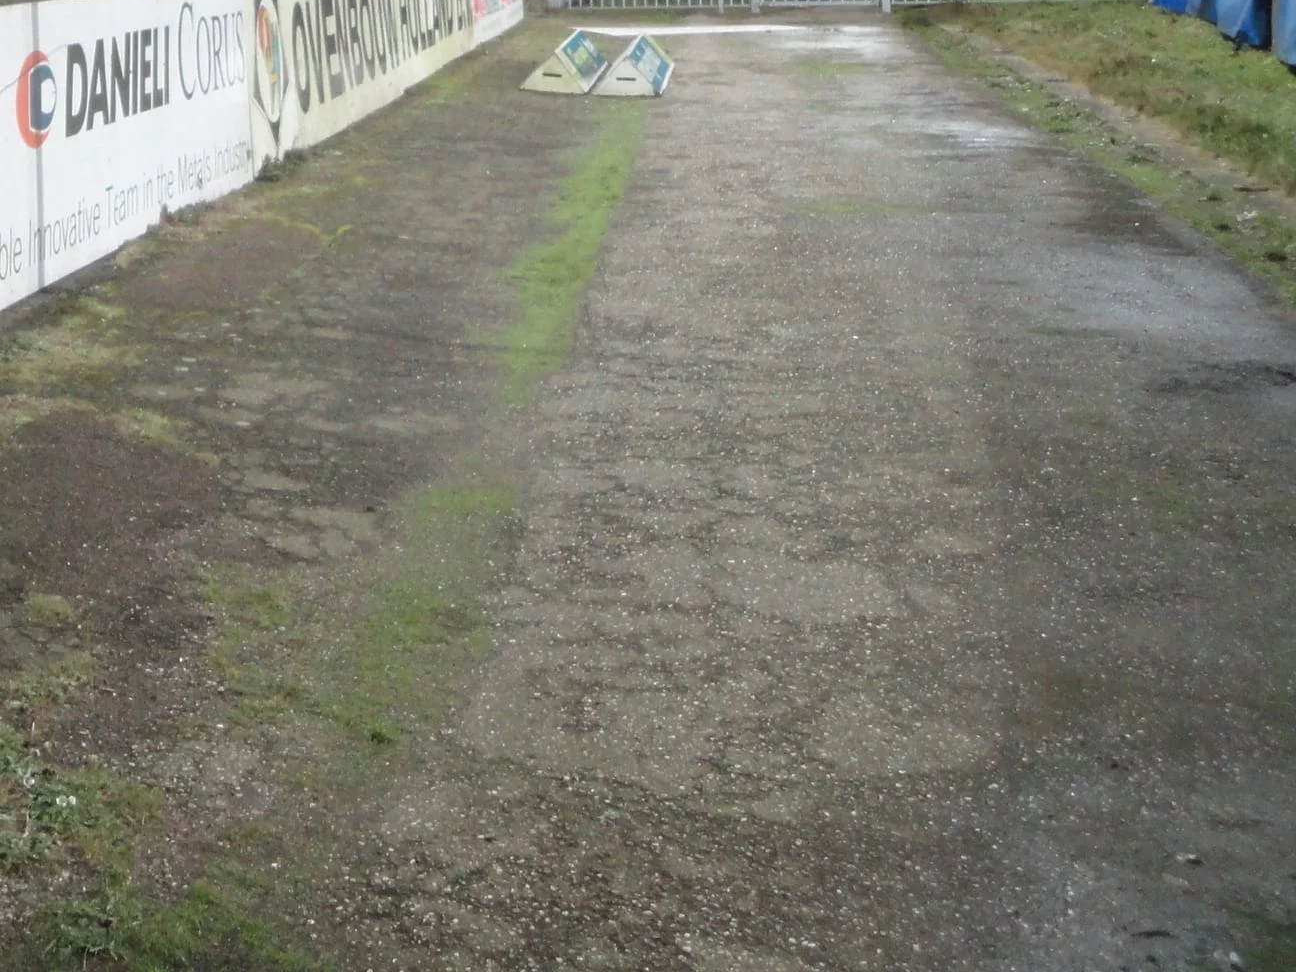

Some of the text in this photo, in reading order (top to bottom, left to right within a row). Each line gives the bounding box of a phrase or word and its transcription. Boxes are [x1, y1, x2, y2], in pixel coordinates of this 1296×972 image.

[65, 25, 170, 138] DANIELI
[28, 196, 101, 268] Innovative
[105, 183, 139, 229] Team
[143, 172, 154, 212] in
[157, 163, 174, 205] the
[178, 148, 212, 196] Metals
[215, 139, 251, 179] Industry
